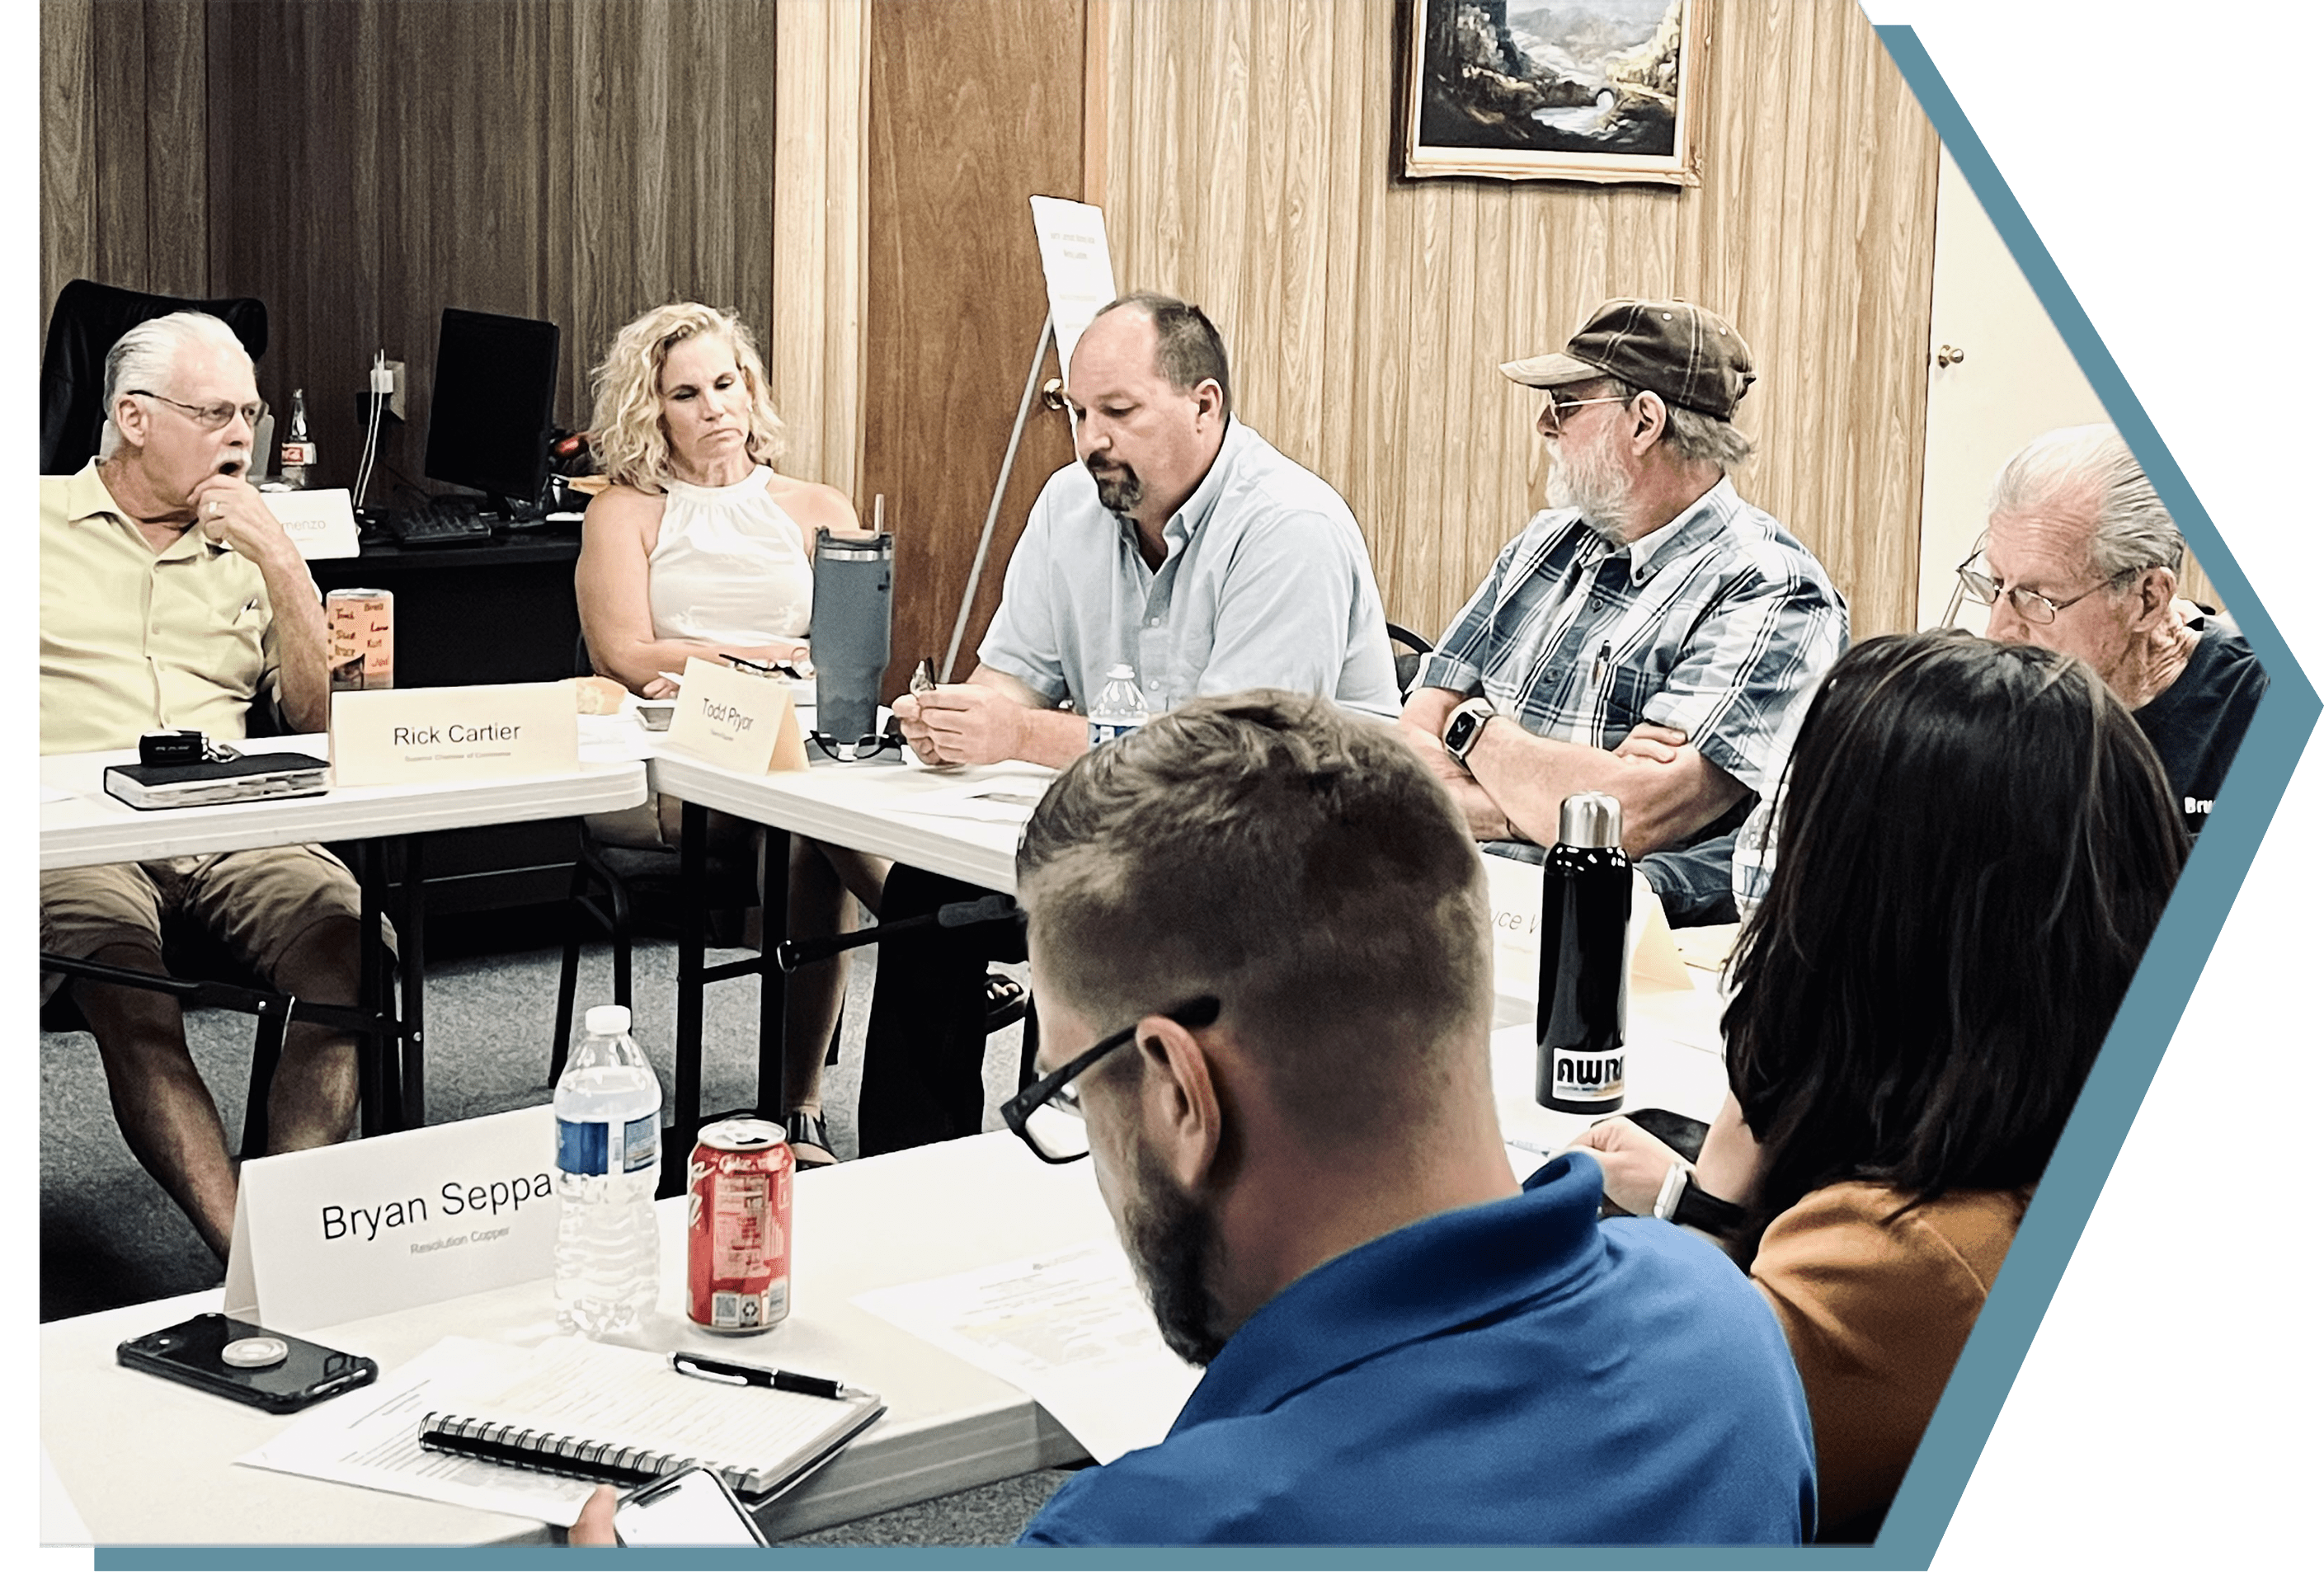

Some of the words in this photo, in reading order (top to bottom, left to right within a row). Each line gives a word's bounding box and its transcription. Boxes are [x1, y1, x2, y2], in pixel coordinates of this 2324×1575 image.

[703, 698, 727, 722] Todd
[394, 726, 440, 745] Rick
[449, 722, 521, 743] Cartier
[2185, 797, 2216, 814] Bru
[1557, 1055, 1623, 1084] AWR
[322, 1197, 427, 1241] Bryan
[441, 1173, 553, 1215] Seppa
